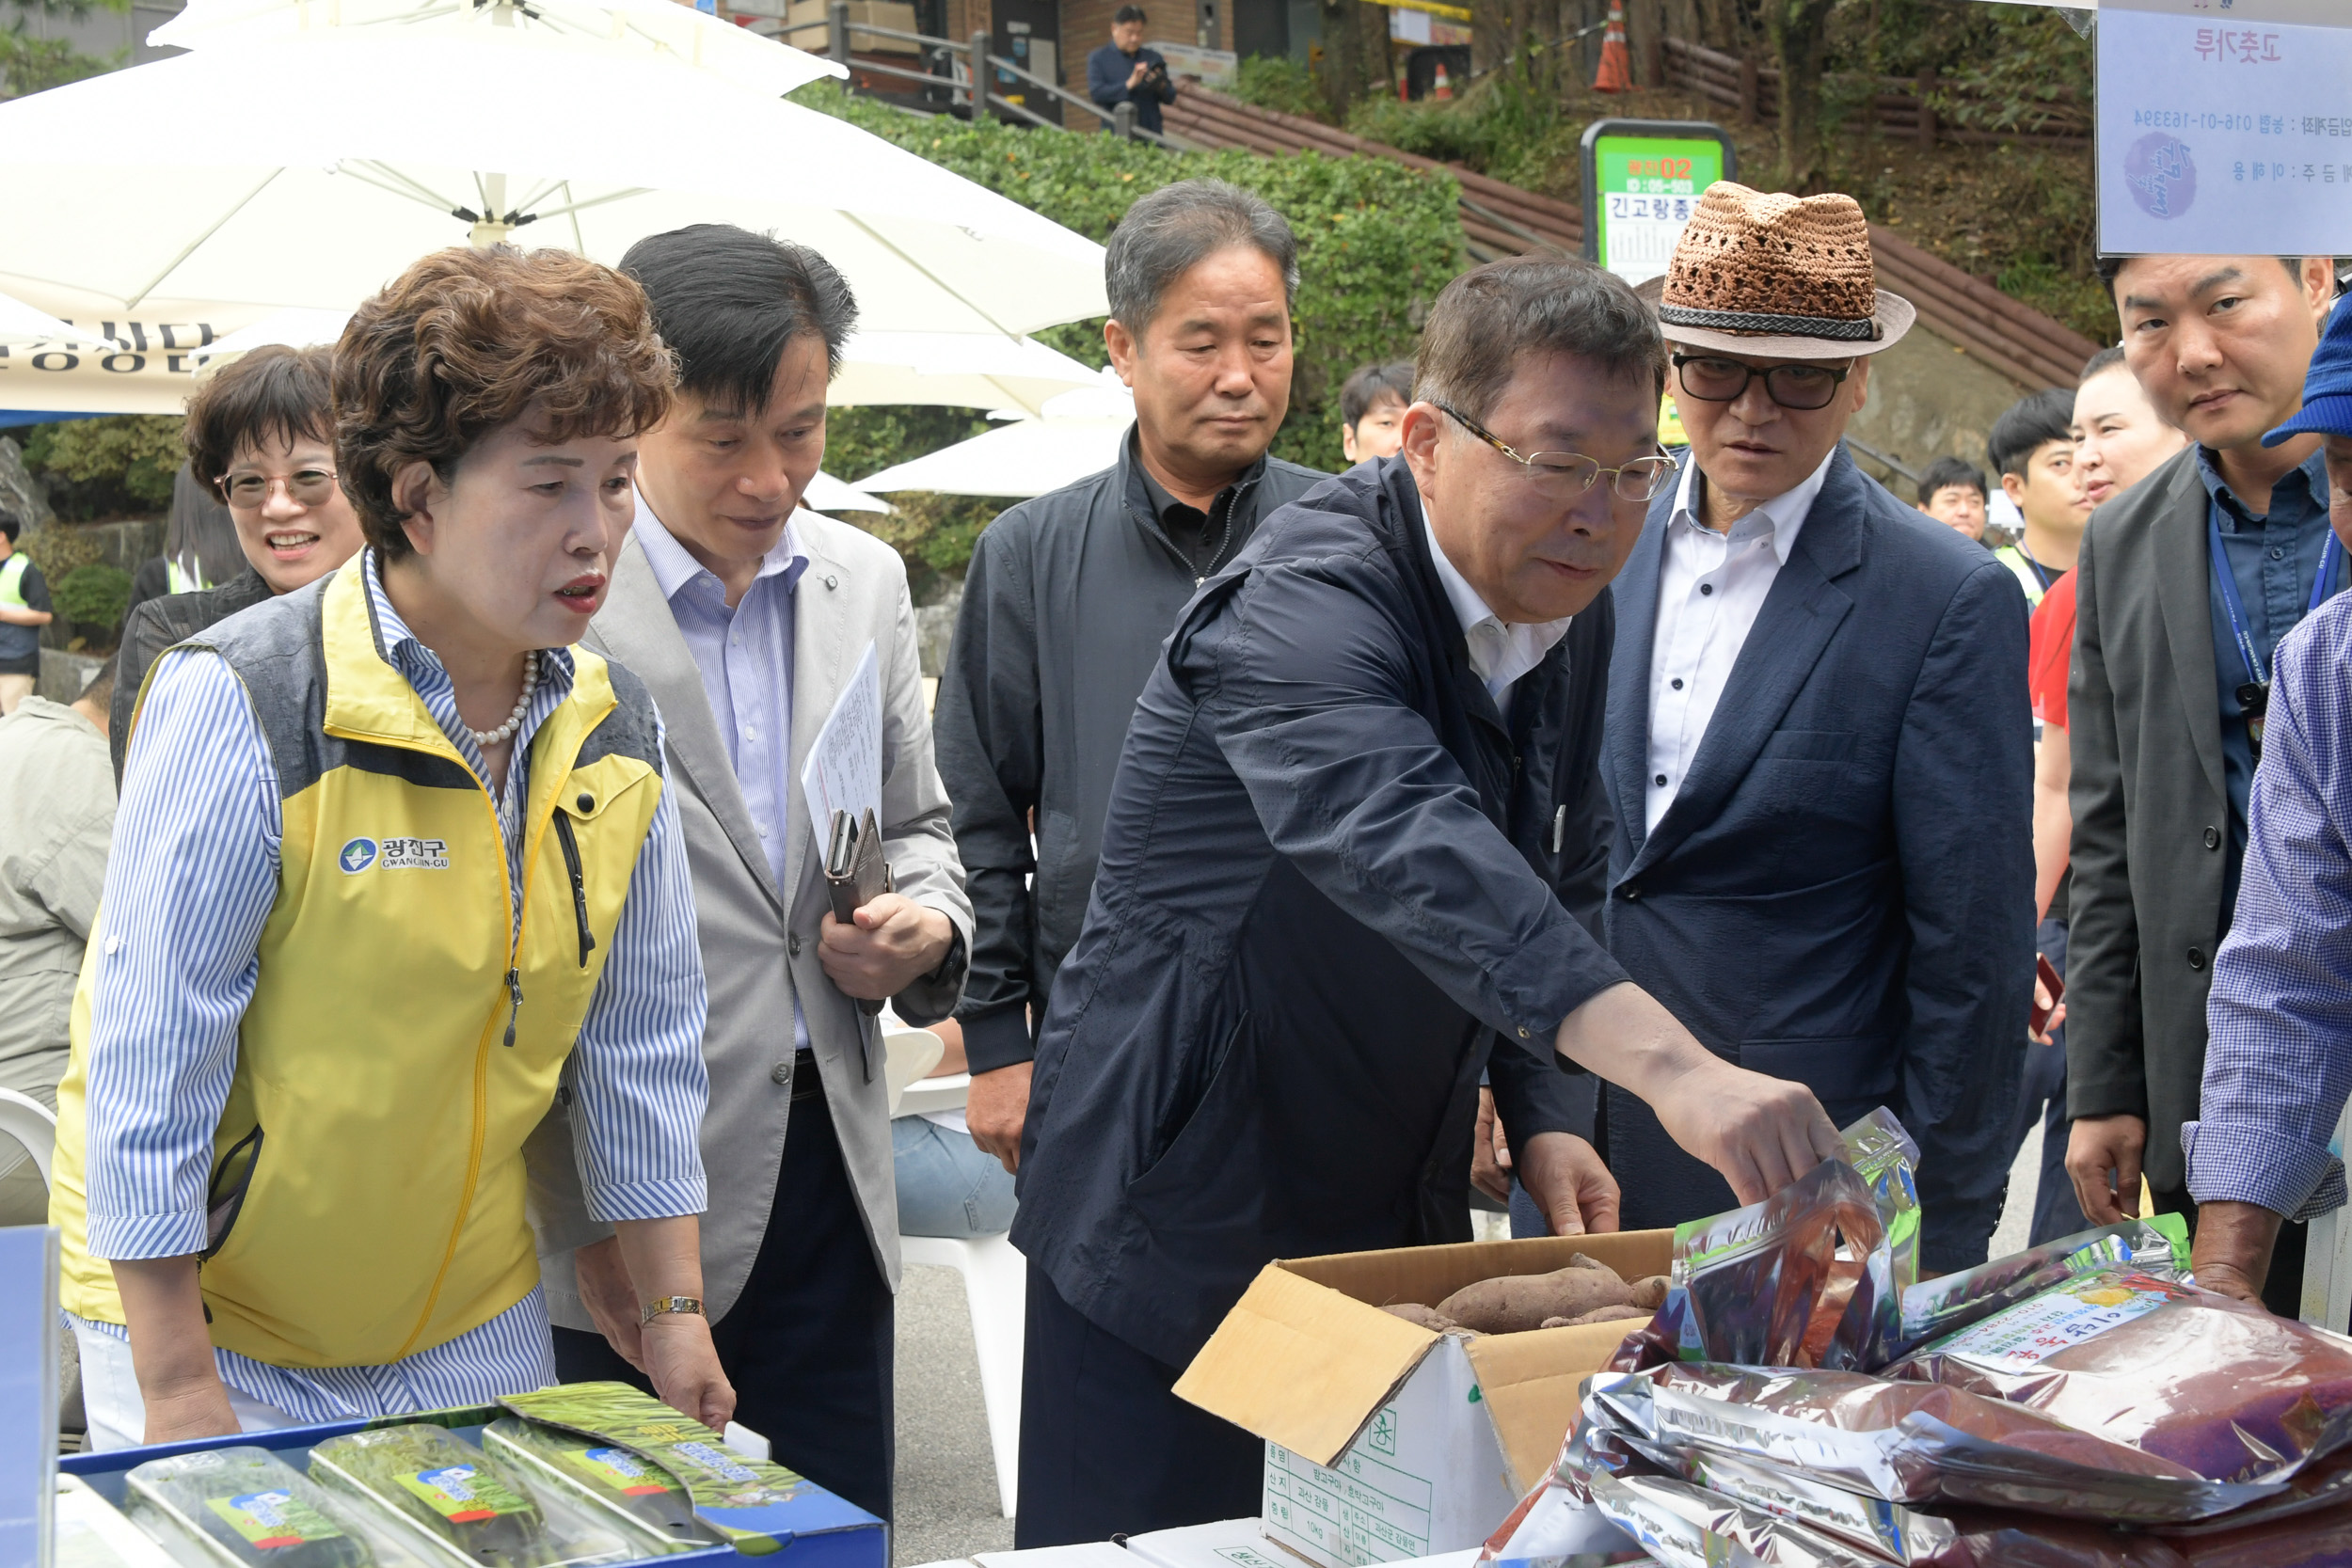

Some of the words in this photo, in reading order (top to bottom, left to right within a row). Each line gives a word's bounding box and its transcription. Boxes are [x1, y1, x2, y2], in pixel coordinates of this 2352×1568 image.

[382, 838, 447, 857] 광진구
[1313, 1467, 1342, 1492] 밤고구마
[1298, 1486, 1312, 1503] 괴산
[1307, 1520, 1324, 1540] 10kg
